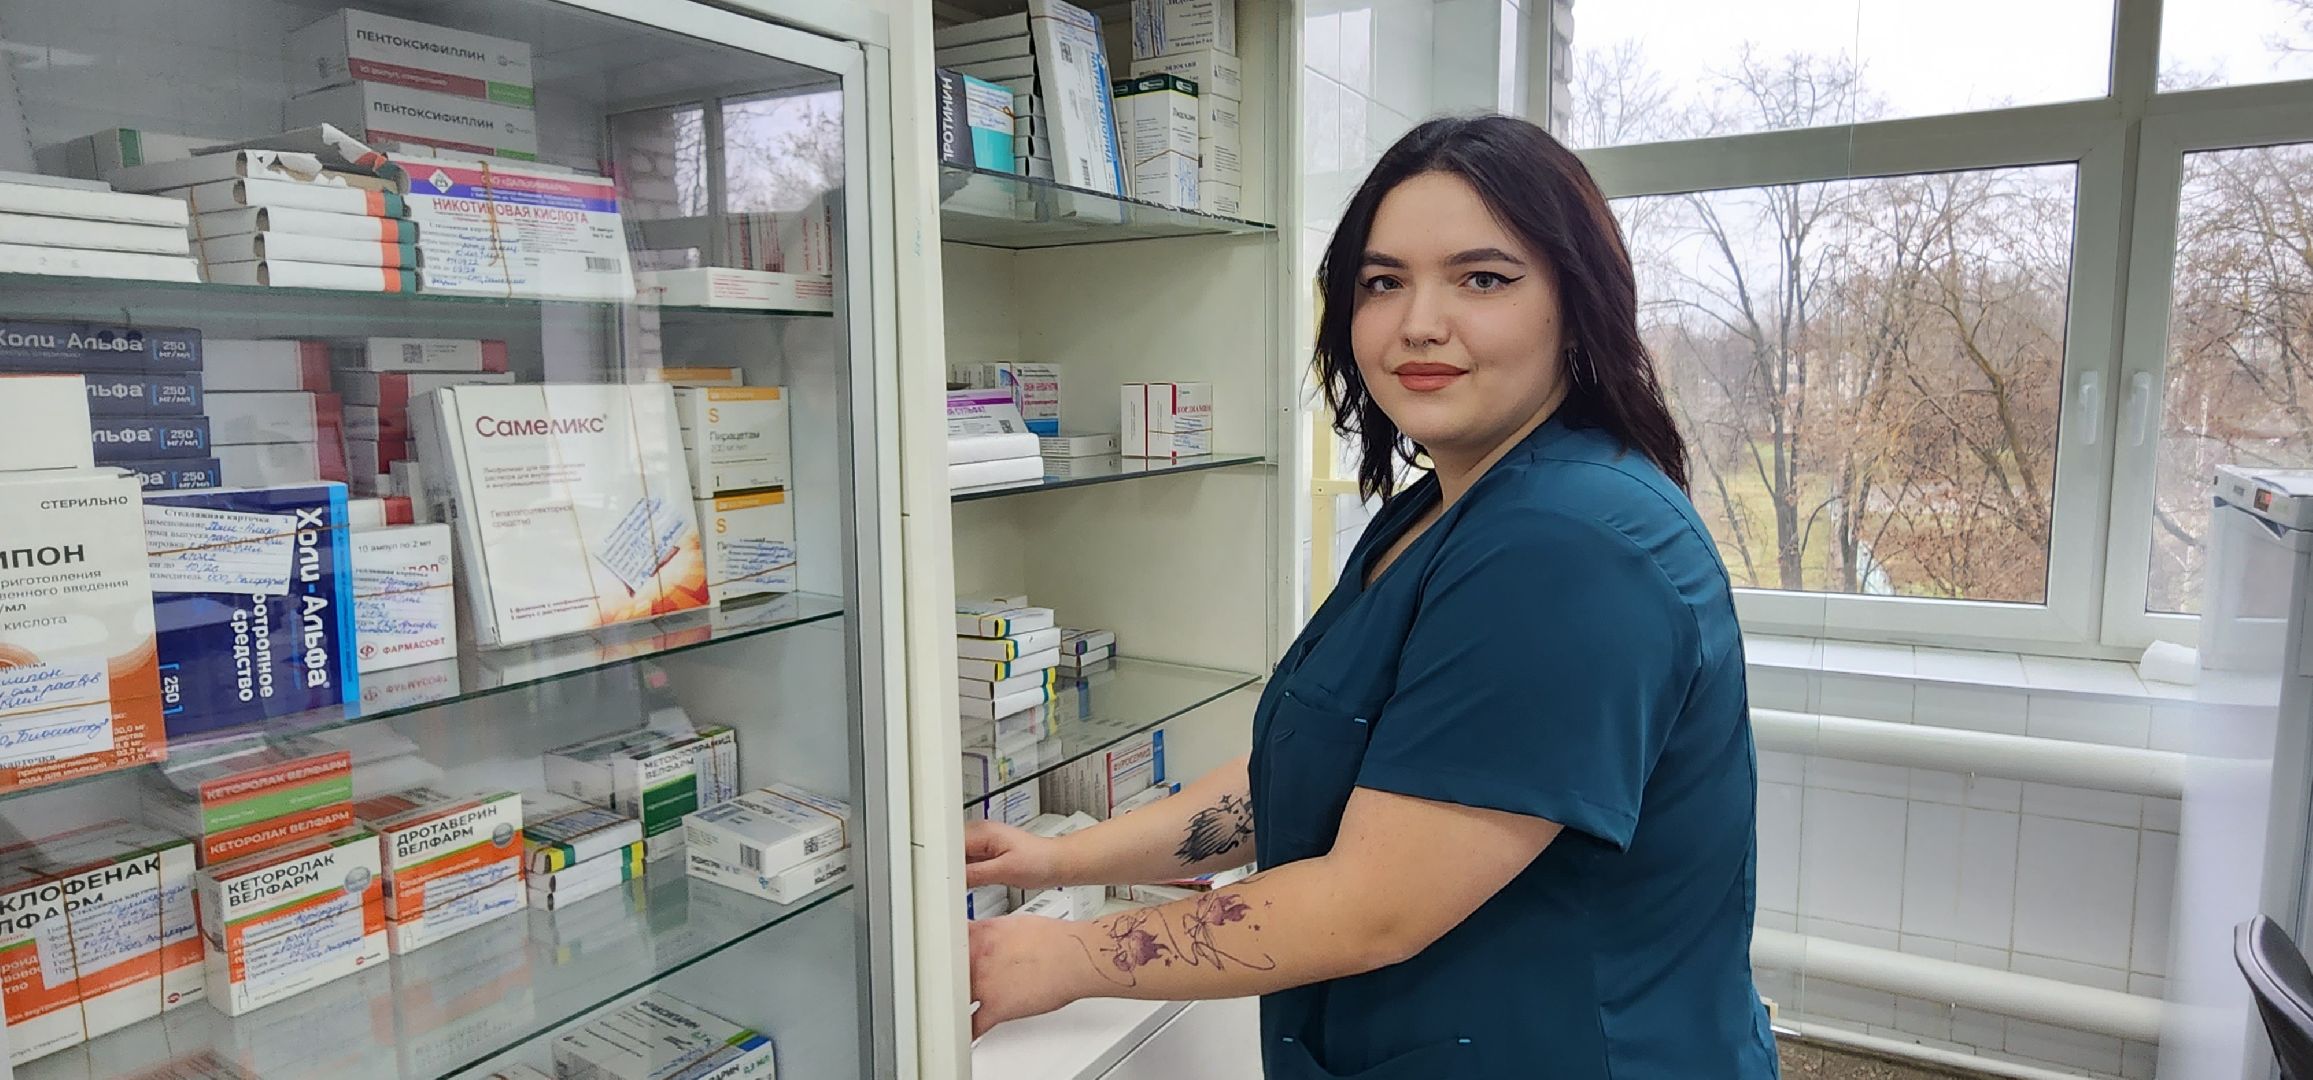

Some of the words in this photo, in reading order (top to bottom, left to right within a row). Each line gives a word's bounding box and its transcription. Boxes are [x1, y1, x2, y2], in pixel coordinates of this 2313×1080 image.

[356, 29, 485, 62] ПЕНТОКСИФИЛЛИН
[373, 101, 494, 129] ПЕНТОКСИФИЛЛИН
[533, 205, 589, 224] КИСЛОТА
[162, 340, 186, 350] 250
[159, 349, 191, 359] мг/мл
[159, 394, 191, 404] мг/мл
[162, 385, 186, 396] 250
[708, 407, 719, 423] S
[170, 429, 194, 439] 250
[475, 414, 604, 437] Самеликс
[166, 438, 198, 448] мг/мл
[182, 471, 206, 481] 250
[40, 495, 128, 510] СТЕРИЛЬНО
[716, 518, 727, 534] S
[63, 580, 129, 594] введения
[4, 615, 67, 632] кислота
[382, 637, 446, 654] ФАРМАСОФТ
[230, 608, 253, 702] средство
[163, 675, 180, 704] 250
[207, 774, 285, 800] КЕТОРОЛАК
[287, 759, 347, 780] ВЕЛФАРМ
[210, 827, 287, 855] КЕТОРОЛАК
[289, 811, 350, 834] ВЕЛФАРМ
[396, 805, 497, 848] ДРОТАВЕРИН
[398, 826, 474, 858] ВЕЛФАРМ
[227, 853, 335, 895] КЕТОРОЛАК
[229, 870, 320, 908] ВЕЛФАРМ
